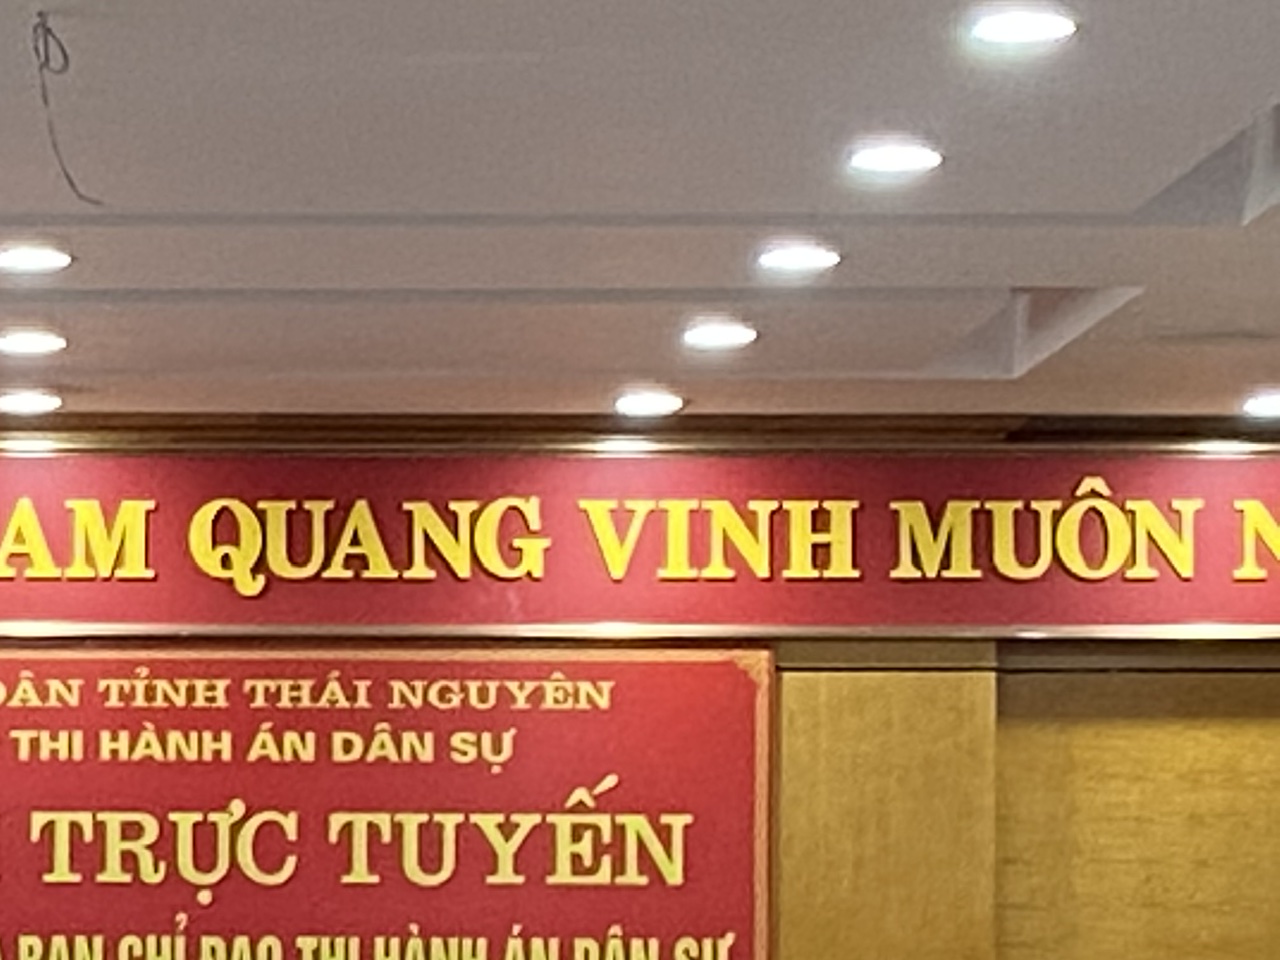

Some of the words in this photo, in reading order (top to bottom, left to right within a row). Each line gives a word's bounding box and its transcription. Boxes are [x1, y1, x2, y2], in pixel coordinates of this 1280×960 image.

[187, 495, 552, 597] QUANG
[578, 499, 861, 581] VINH
[889, 476, 1205, 582] MUÔN
[97, 666, 232, 709] TỈNH
[243, 669, 372, 710] THÁI
[387, 671, 616, 711] NGUYÊN
[9, 729, 84, 762] THI
[99, 721, 232, 763] HÀNH
[246, 721, 316, 763] ÁN
[332, 721, 435, 764] DÂN
[449, 727, 518, 775] SỰ
[29, 798, 298, 906] TRỰC
[328, 774, 694, 887] TUYẾN
